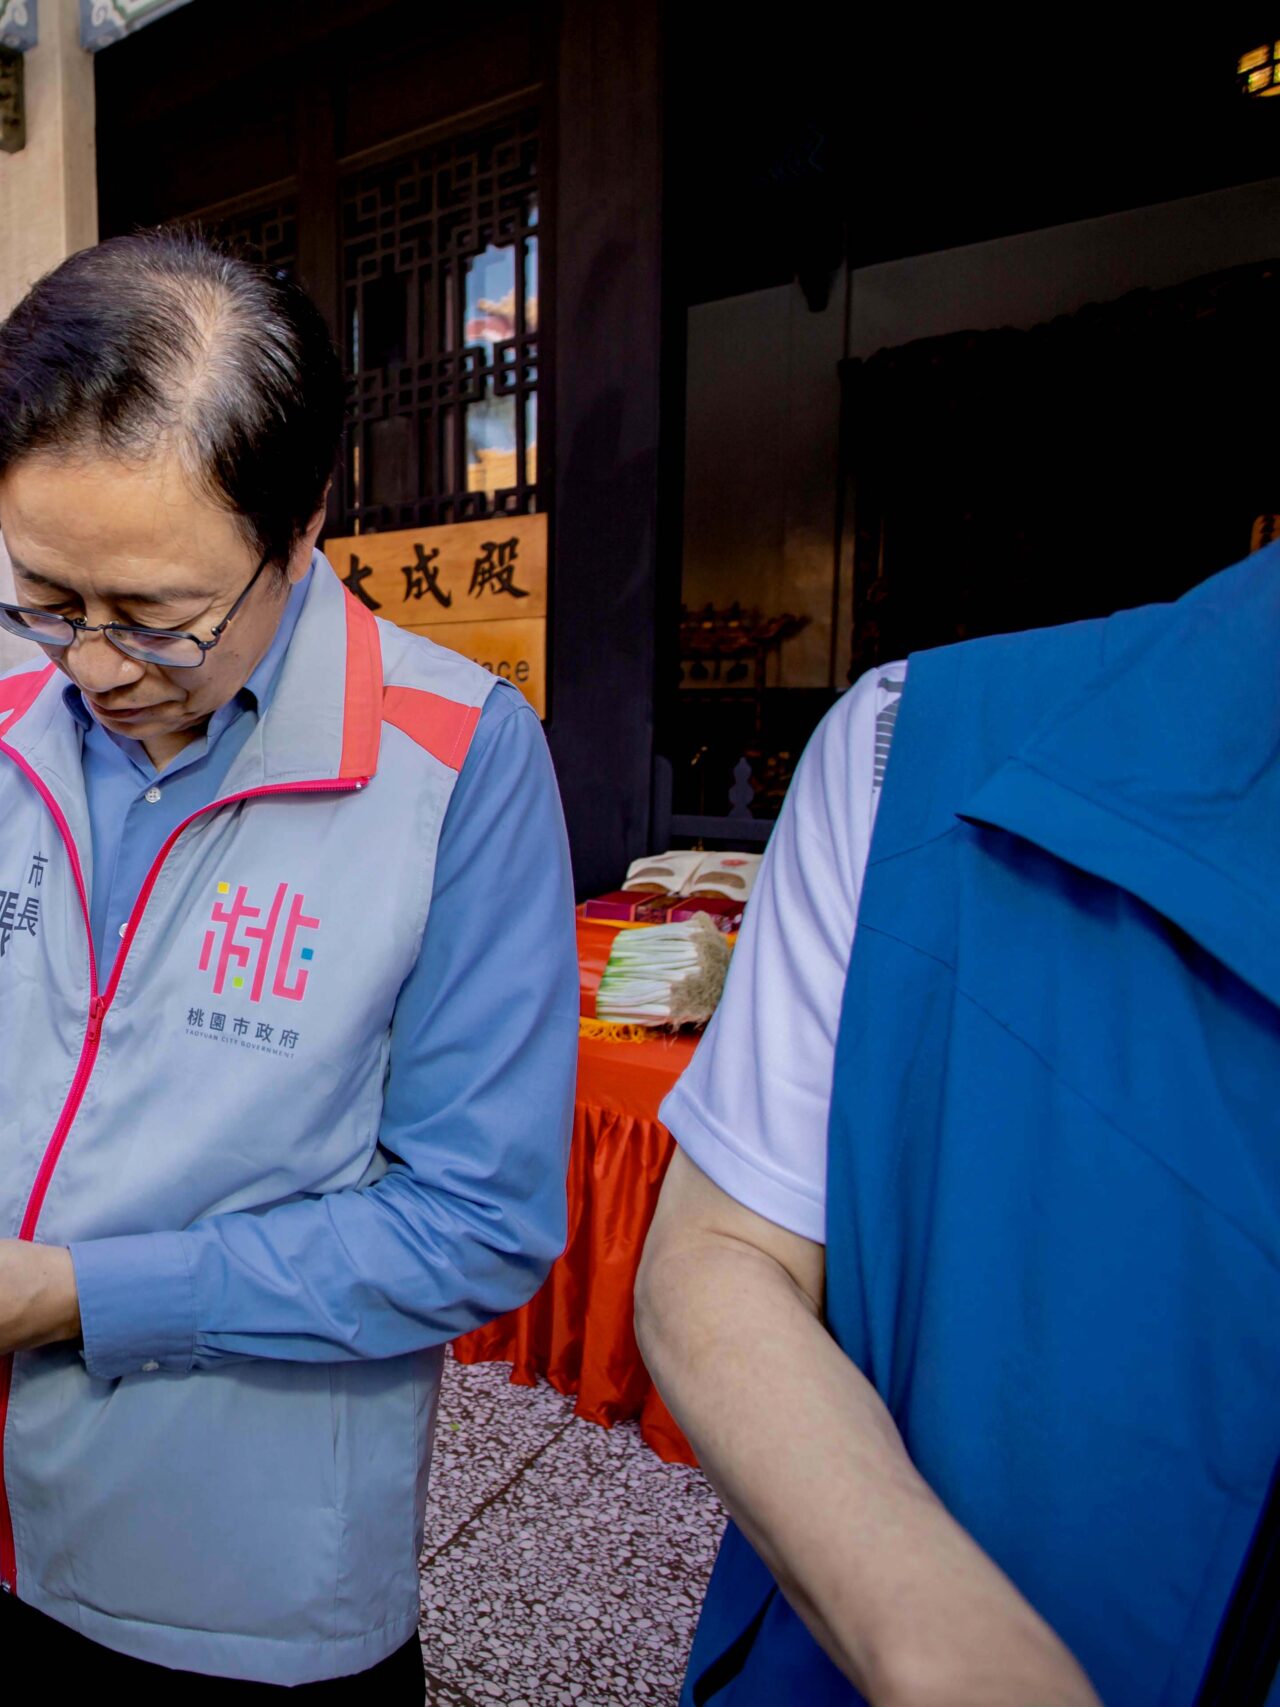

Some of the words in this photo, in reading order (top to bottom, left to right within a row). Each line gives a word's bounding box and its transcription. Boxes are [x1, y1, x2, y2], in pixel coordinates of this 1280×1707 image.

[342, 537, 530, 612] 大成殿
[14, 851, 49, 937] 市長
[186, 1007, 300, 1049] 桃園市政府
